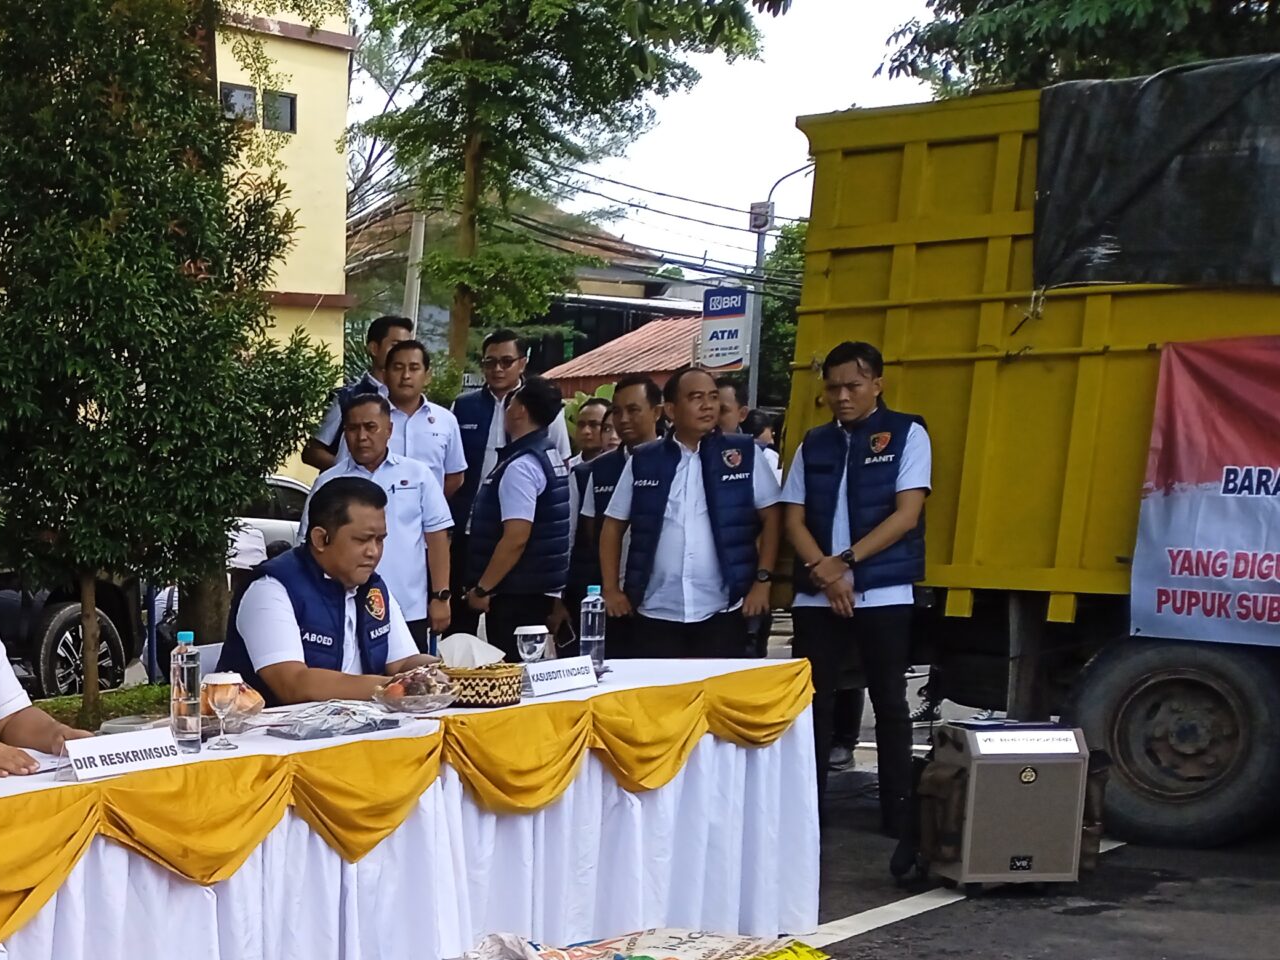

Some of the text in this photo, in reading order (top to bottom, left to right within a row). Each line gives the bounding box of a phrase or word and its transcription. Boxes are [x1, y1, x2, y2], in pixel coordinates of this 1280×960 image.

[722, 295, 741, 308] BRI
[708, 329, 739, 341] ATM
[1167, 549, 1228, 577] YANG
[1156, 588, 1232, 619] PUPUK
[302, 632, 333, 645] ABOED
[73, 745, 178, 770] DIR RESKRIMSUS
